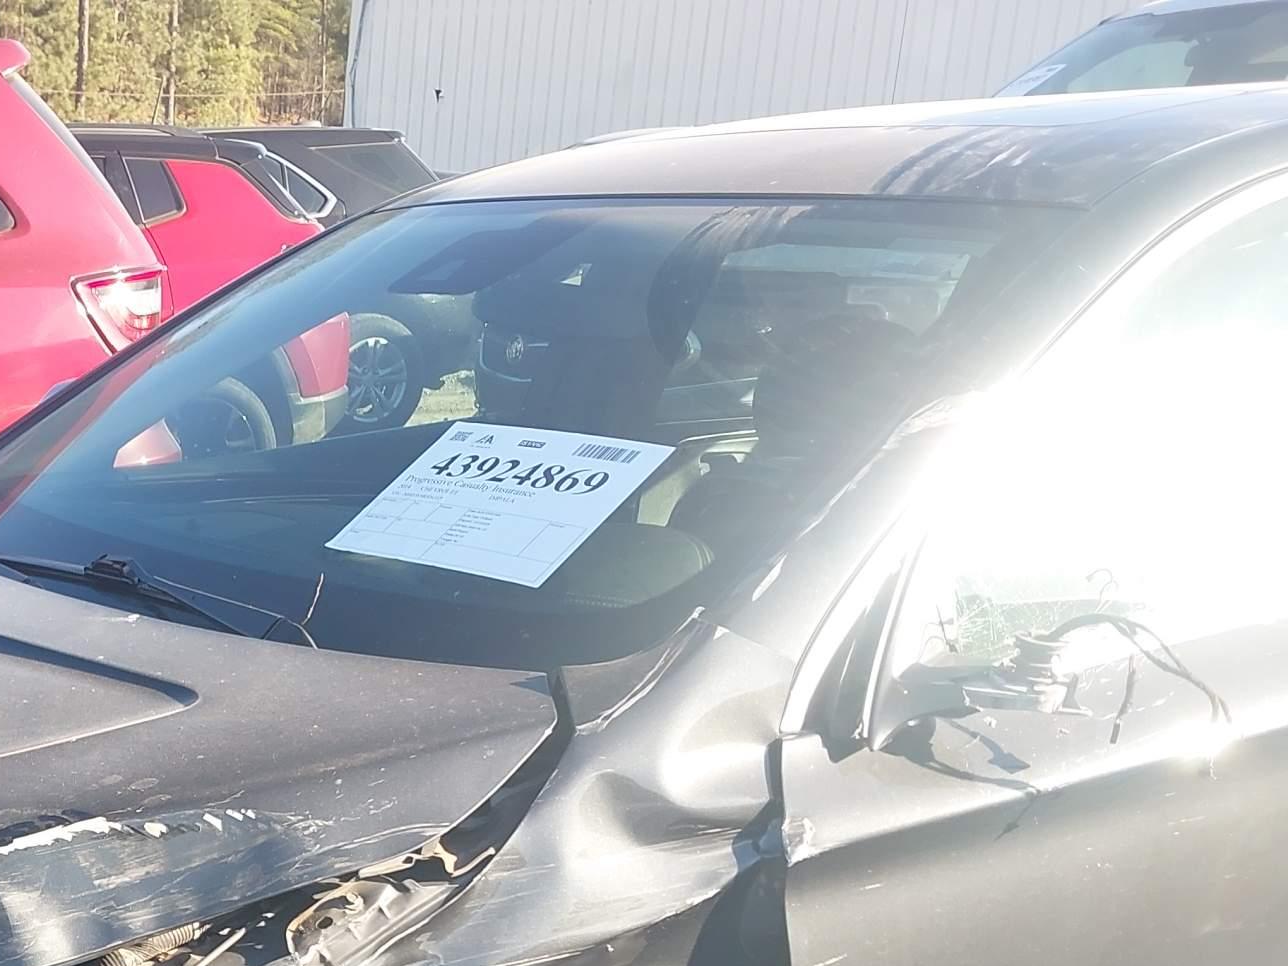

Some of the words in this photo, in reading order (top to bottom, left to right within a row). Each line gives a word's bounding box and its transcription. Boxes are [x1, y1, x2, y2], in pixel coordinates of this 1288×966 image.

[405, 474, 454, 487] Progressive
[454, 480, 489, 493] Casualty
[492, 484, 537, 498] Insurance
[430, 452, 610, 495] 43924869
